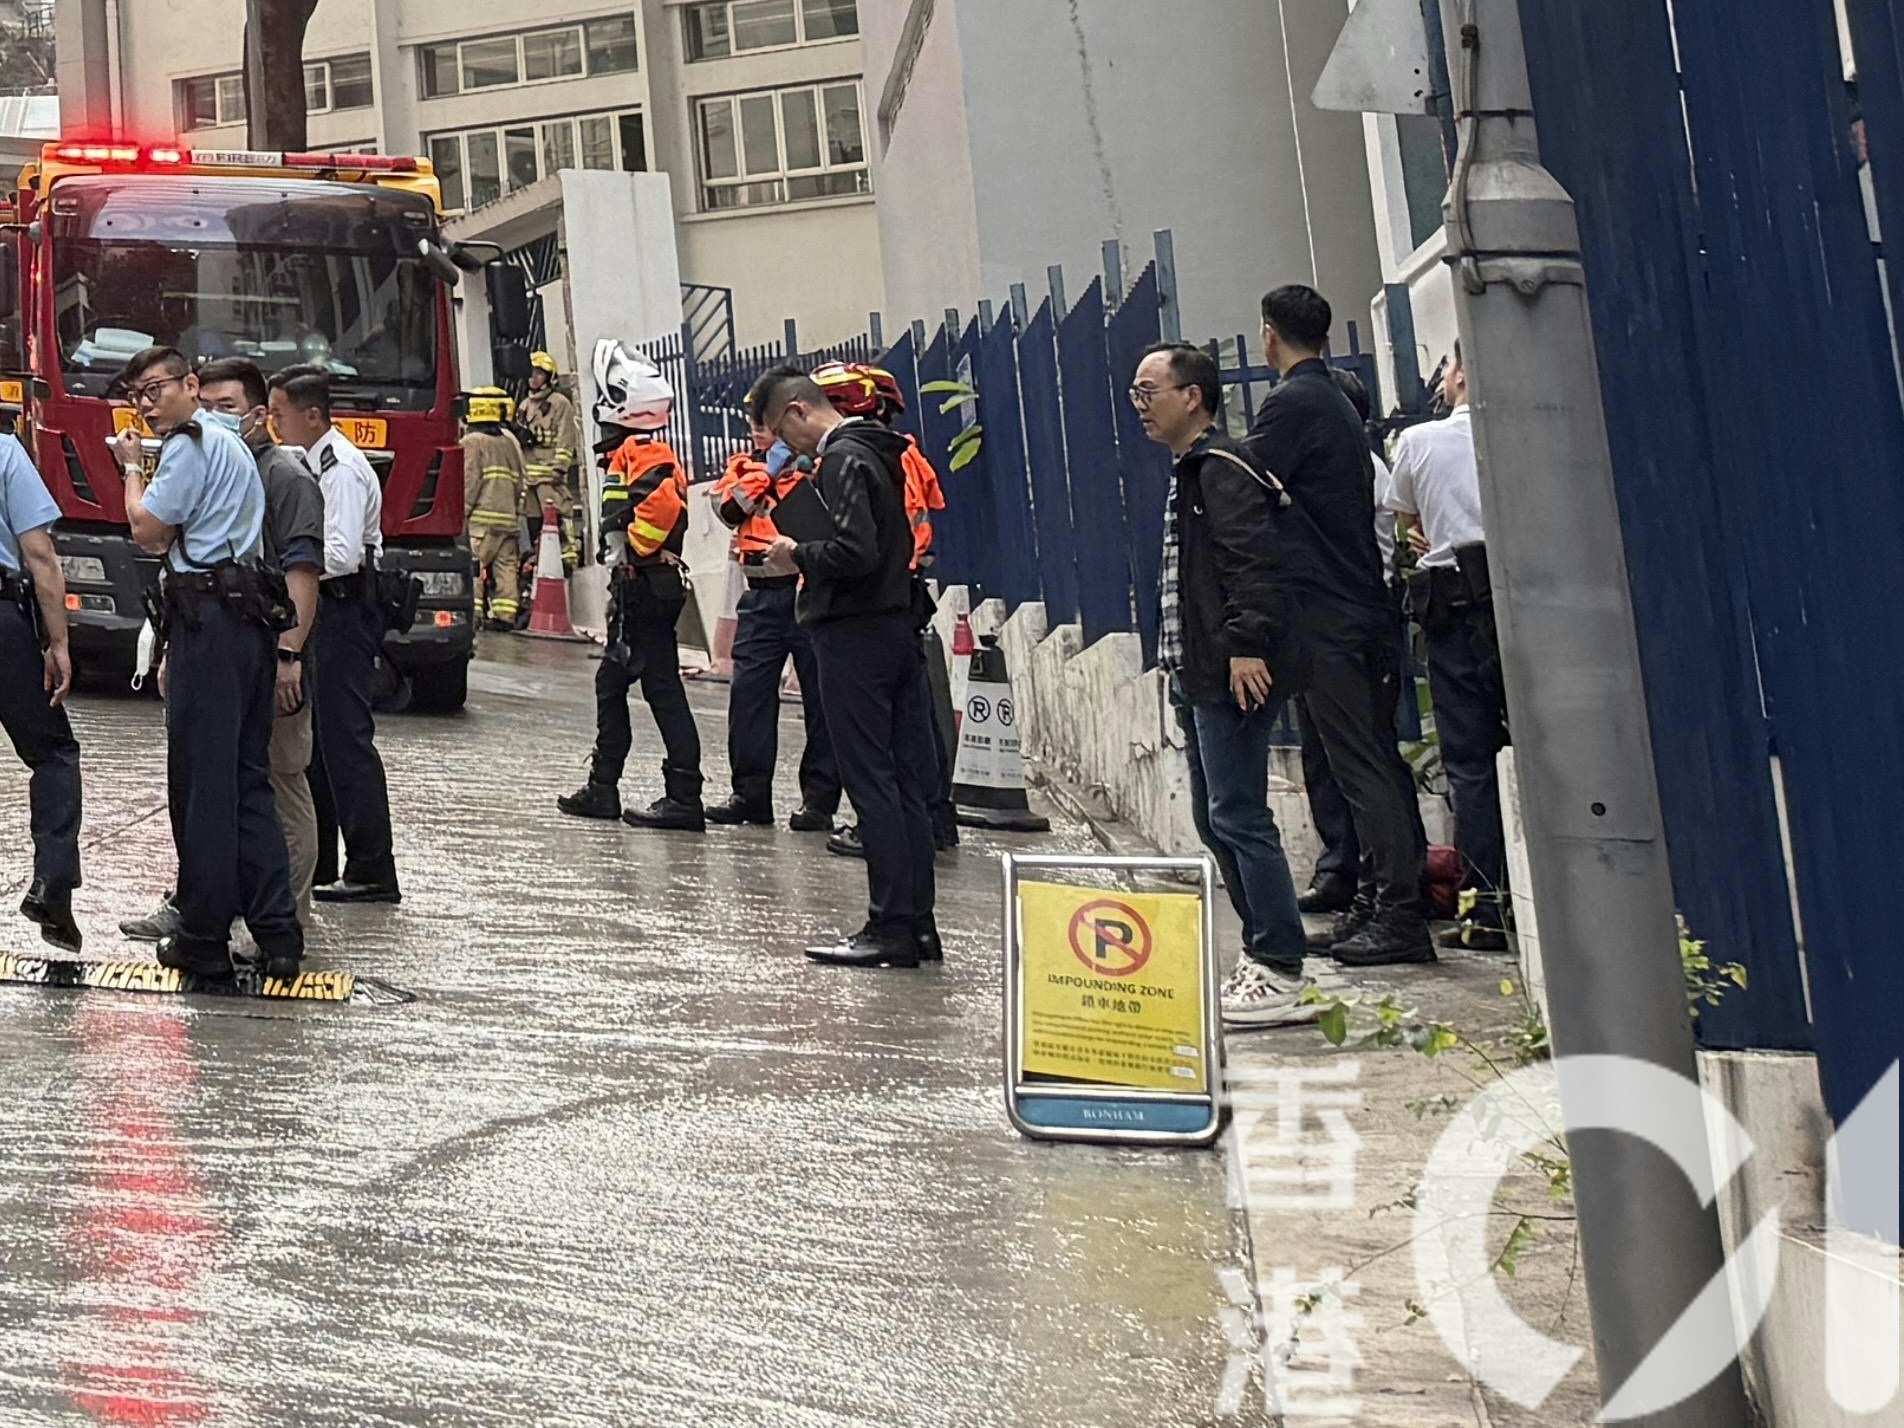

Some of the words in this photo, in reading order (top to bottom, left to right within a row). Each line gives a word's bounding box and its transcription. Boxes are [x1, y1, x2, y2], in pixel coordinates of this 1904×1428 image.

[1047, 974, 1136, 994] IMPOUNDING
[1139, 985, 1175, 999] ZONE
[1082, 1108, 1145, 1121] BONHAM
